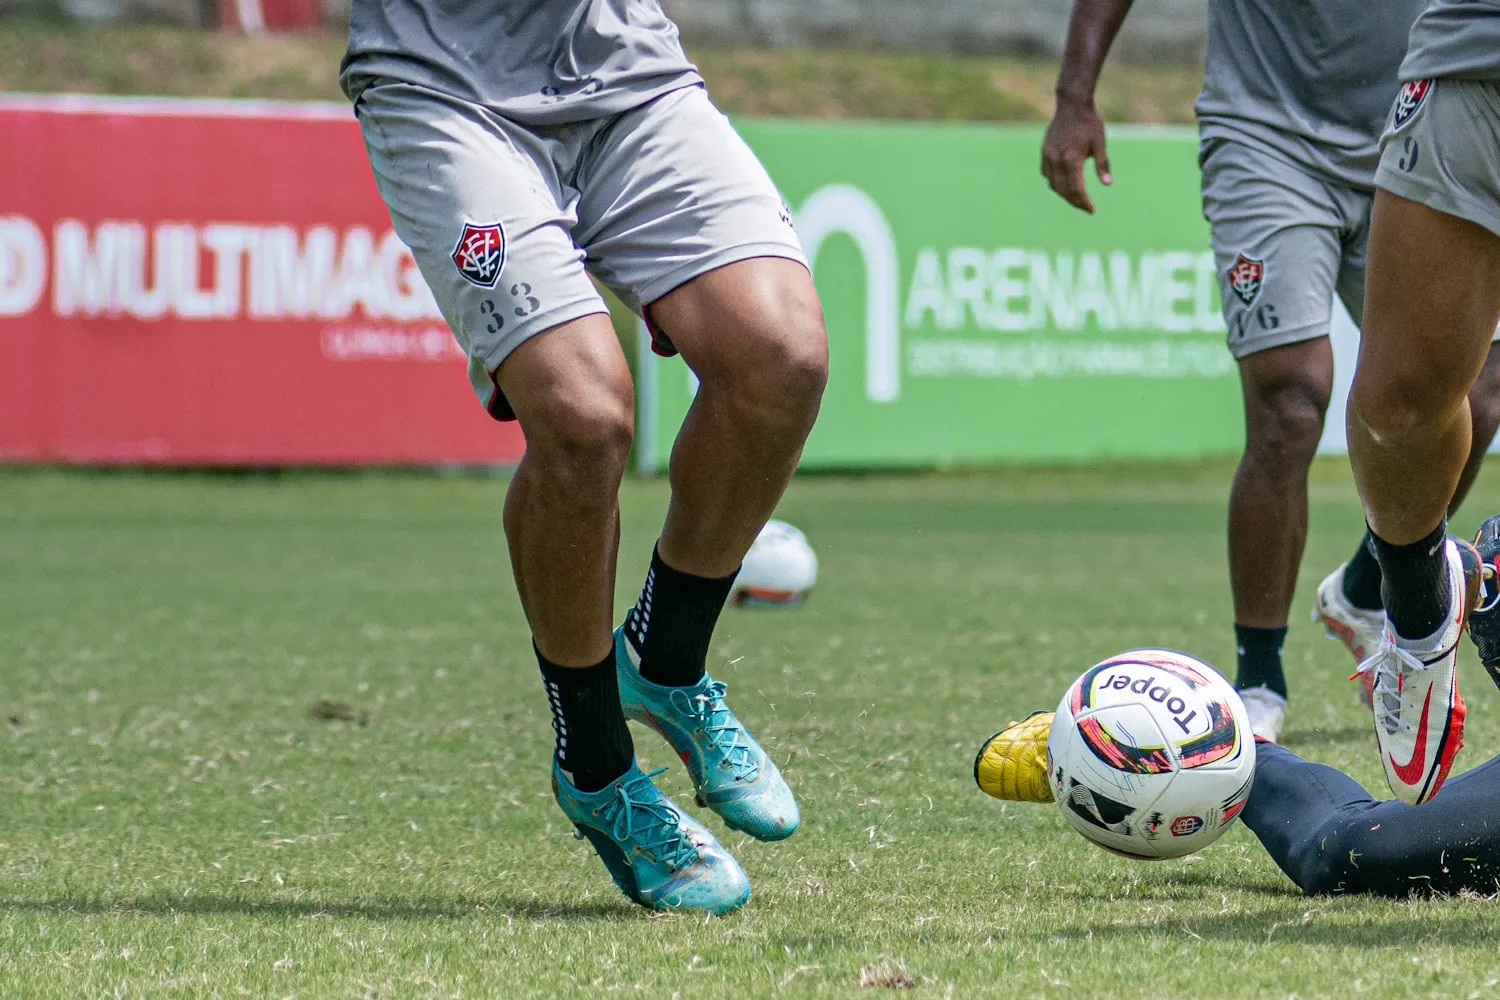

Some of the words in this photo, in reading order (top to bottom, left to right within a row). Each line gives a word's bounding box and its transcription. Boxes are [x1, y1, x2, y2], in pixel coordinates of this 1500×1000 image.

[53, 217, 443, 320] MULTIMAG
[480, 282, 540, 334] 33
[1098, 673, 1198, 735] Topper
